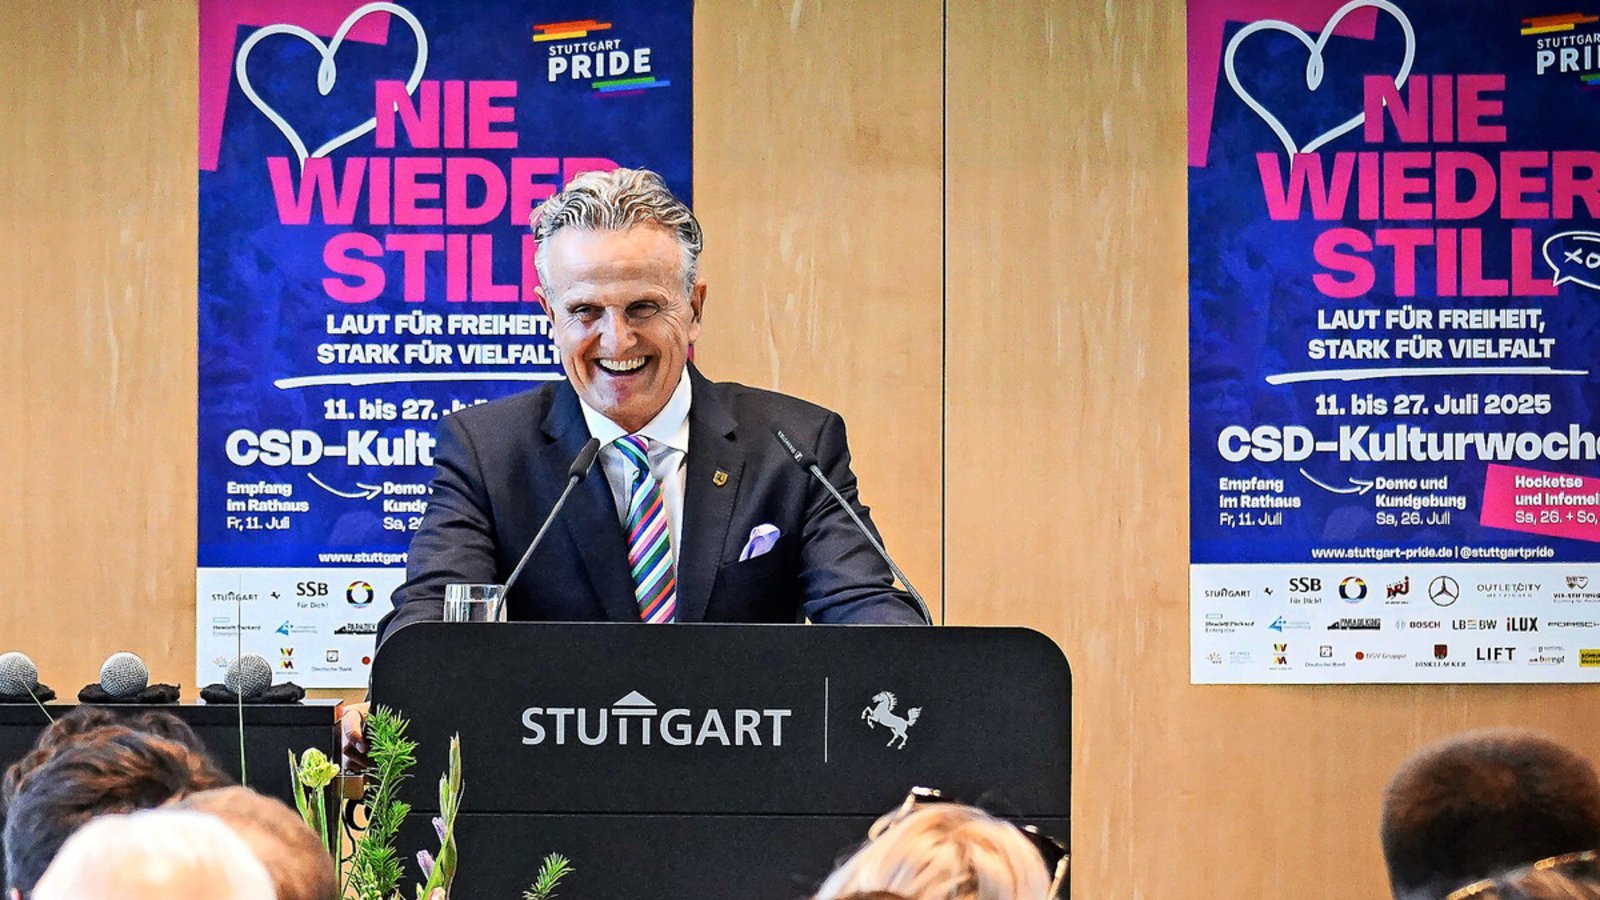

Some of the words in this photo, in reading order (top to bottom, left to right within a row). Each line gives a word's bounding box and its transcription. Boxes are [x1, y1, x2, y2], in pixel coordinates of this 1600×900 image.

[548, 39, 621, 56] STUTTGART
[1537, 33, 1600, 49] STUTTGAR
[548, 48, 652, 82] PRIDE
[1536, 45, 1600, 76] PRI
[375, 80, 518, 149] NIE
[1363, 75, 1507, 143] NIE
[267, 157, 620, 225] WIEDE
[1256, 151, 1600, 220] WIEDER
[1312, 227, 1558, 299] STILL
[326, 314, 389, 335] LAUT
[395, 310, 443, 335] FÜR
[448, 314, 554, 338] FREIHEIT,
[1317, 309, 1380, 330] LAUT
[1385, 305, 1433, 330] FÜR
[1438, 309, 1545, 333] FREIHEIT,
[316, 344, 399, 365] STARK
[404, 340, 452, 364] FÜR
[459, 344, 562, 365] VIELFALT
[1307, 339, 1389, 360] STARK
[1395, 335, 1443, 359] FÜR
[1449, 339, 1555, 359] VIELFALT
[324, 399, 354, 420] 11.
[359, 399, 397, 421] bis
[402, 399, 438, 420] 27.
[1315, 395, 1345, 416] 11.
[1351, 394, 1389, 416] bis
[1393, 395, 1429, 416] 27.
[1434, 394, 1478, 415] Juli
[1484, 394, 1552, 415] 2025
[225, 429, 436, 466] CSD-Kult
[1217, 424, 1600, 462] CSD-Kulturwoch
[226, 481, 293, 497] Empfang
[383, 481, 426, 495] Demo
[1219, 477, 1284, 494] Empfang
[1375, 476, 1417, 490] Demo
[1420, 476, 1447, 490] und
[1515, 475, 1583, 488] Hocketse
[226, 499, 245, 512] im
[248, 499, 309, 512] Rathaus
[1219, 495, 1238, 508] im
[1240, 495, 1301, 509] Rathaus
[1375, 494, 1466, 510] Kundgebung
[1515, 493, 1542, 505] und
[1545, 492, 1600, 505] Infomei
[226, 517, 243, 531] Fr,
[246, 517, 262, 530] 11.
[266, 516, 290, 530] Juli
[383, 517, 405, 532] Sa,
[1219, 513, 1236, 528] Fr,
[1238, 513, 1256, 526] 11.
[1258, 512, 1283, 526] Juli
[1375, 512, 1398, 527] Sa,
[1400, 512, 1424, 525] 26.
[1427, 511, 1451, 525] Juli
[1515, 510, 1537, 526] Sa,
[1540, 510, 1563, 523] 26.
[1576, 510, 1599, 526] So,
[318, 552, 409, 565] www.stuttgart
[1311, 547, 1452, 560] www.stuttgart-pride.de
[1460, 546, 1555, 560] @stuttgartpride
[296, 581, 328, 597] SSB
[1289, 577, 1322, 593] SSB
[1409, 621, 1441, 629] BOSCH
[1476, 647, 1516, 661] LIFT
[521, 690, 792, 746] STUTTGART
